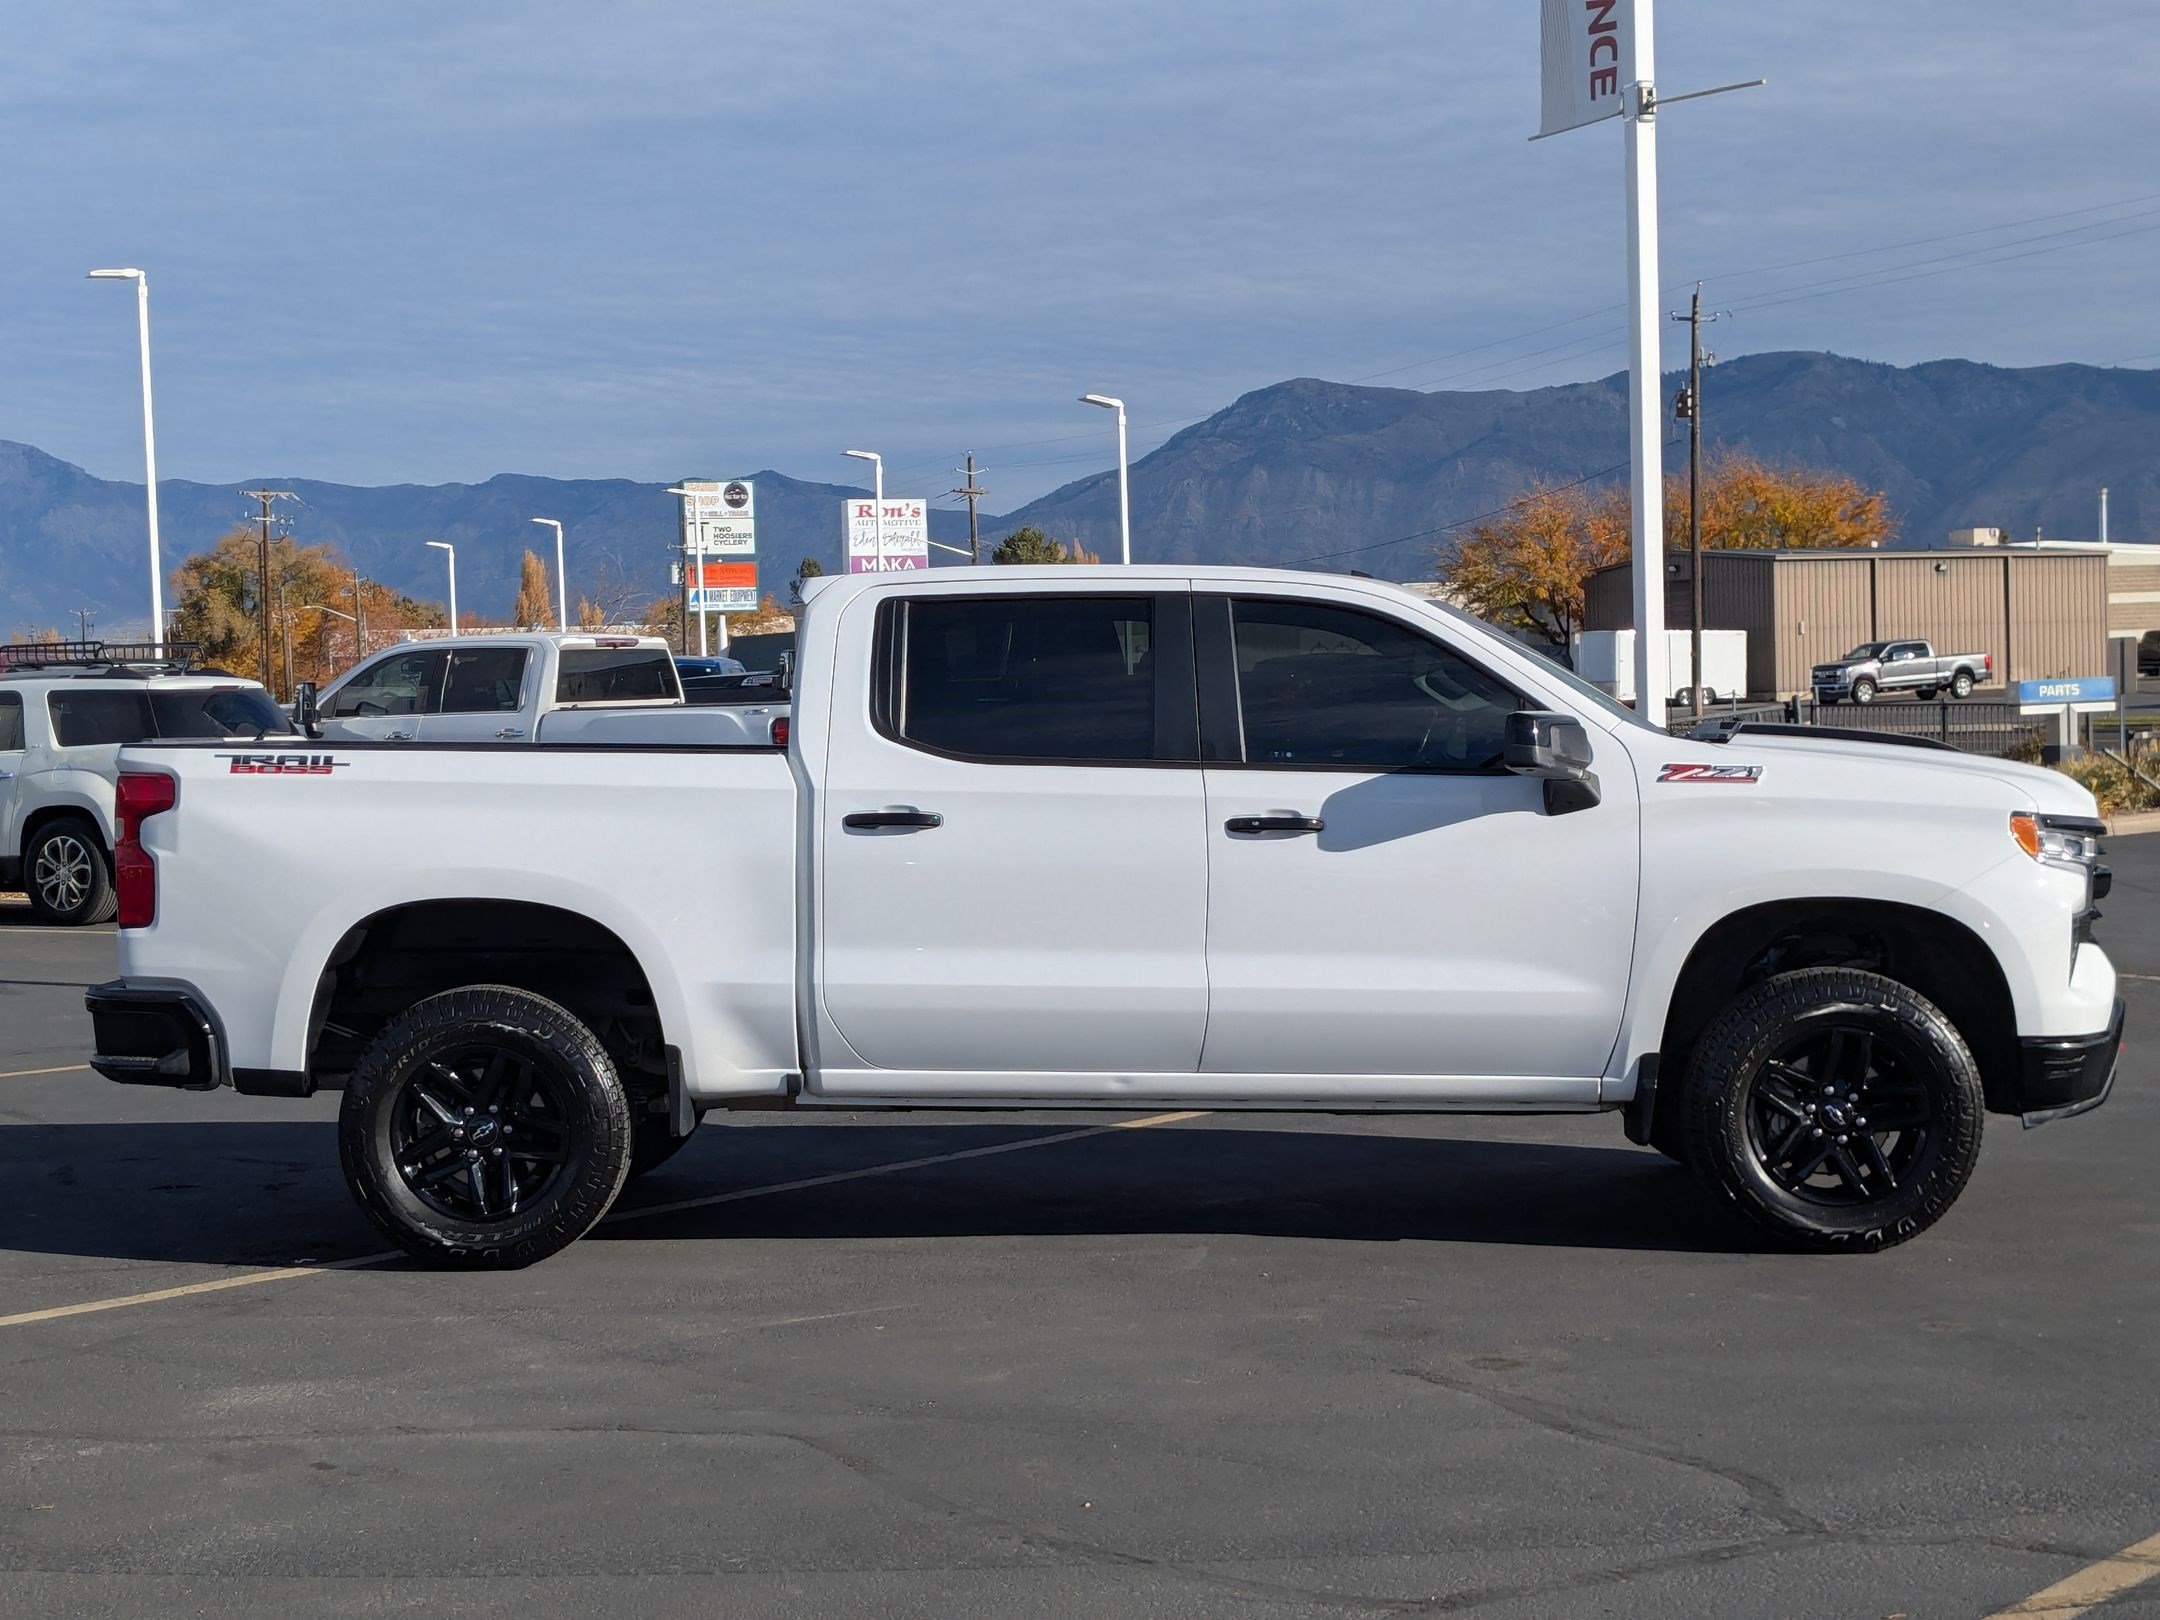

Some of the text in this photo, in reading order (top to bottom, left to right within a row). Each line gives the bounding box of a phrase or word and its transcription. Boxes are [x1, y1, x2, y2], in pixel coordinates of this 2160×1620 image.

[686, 495, 720, 506] SOP
[854, 519, 921, 527] AUTMOTIVE
[861, 557, 916, 572] MAKA
[709, 589, 728, 602] MARKET
[2039, 683, 2080, 698] PARTS
[214, 754, 351, 766] TRAIL
[230, 764, 333, 775] BOSS
[1656, 763, 1762, 784] Z71
